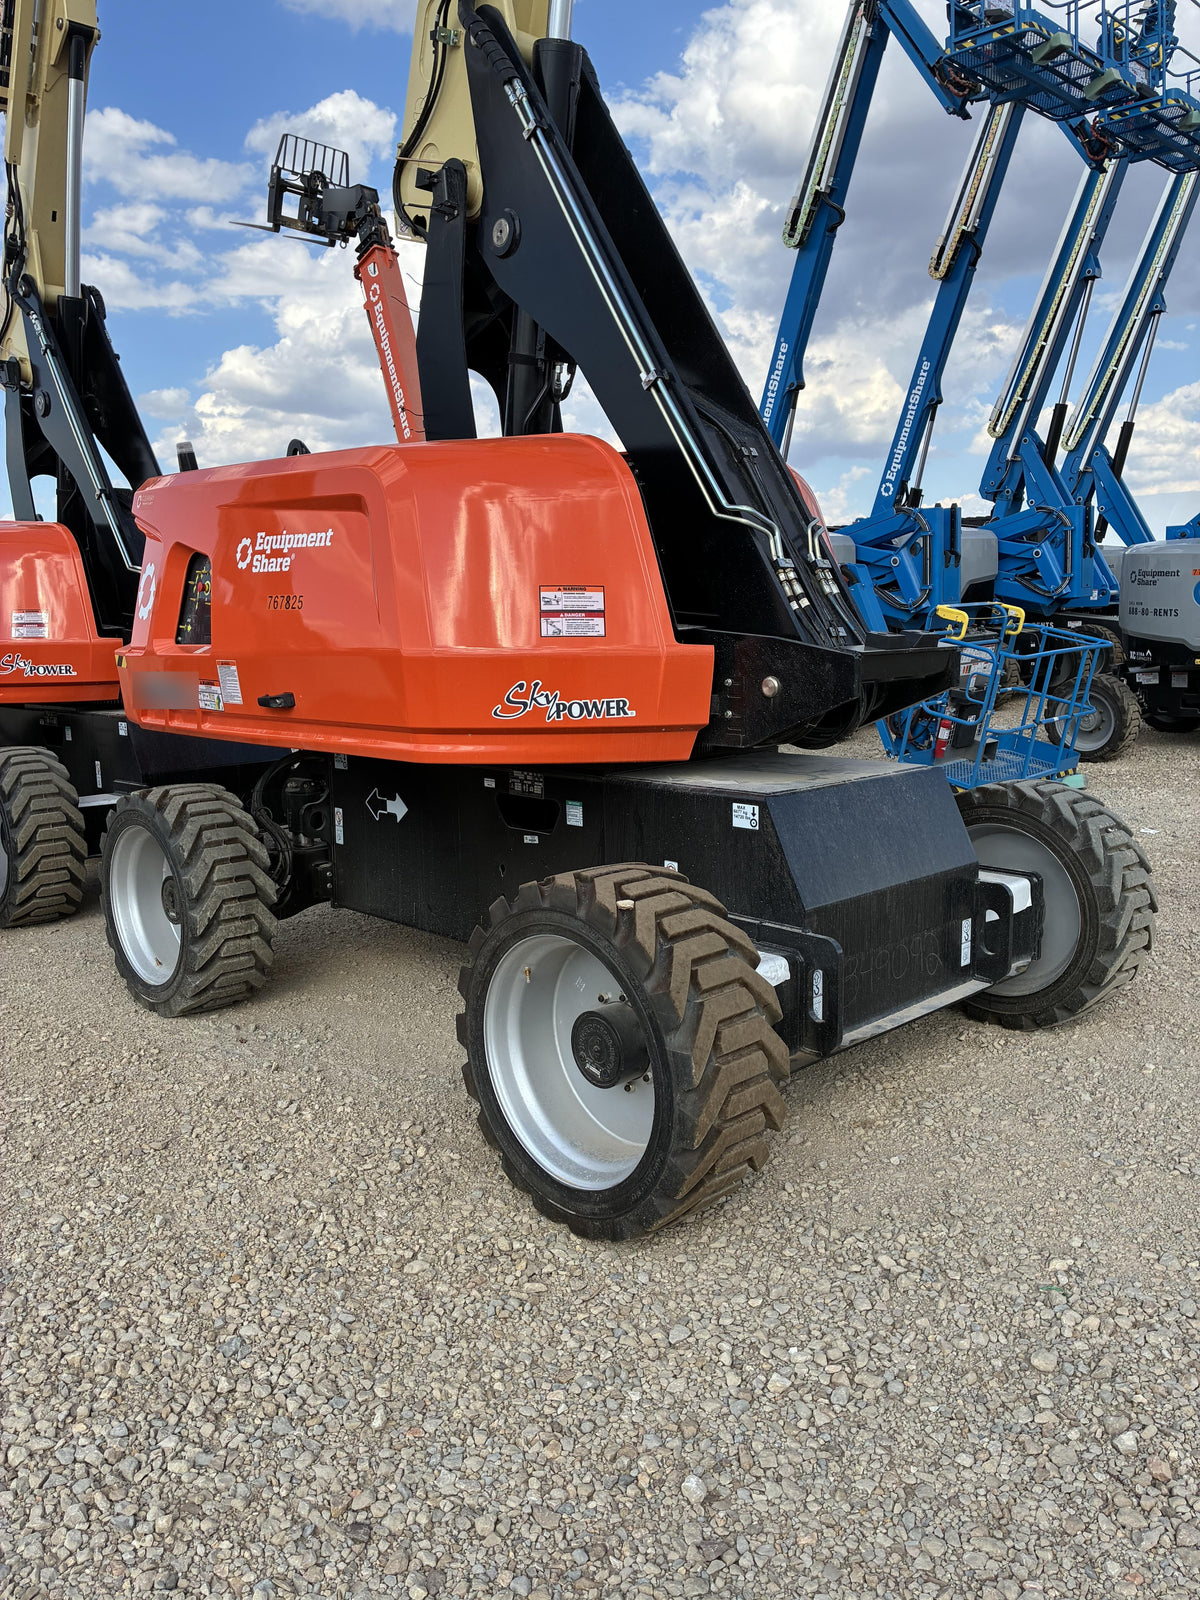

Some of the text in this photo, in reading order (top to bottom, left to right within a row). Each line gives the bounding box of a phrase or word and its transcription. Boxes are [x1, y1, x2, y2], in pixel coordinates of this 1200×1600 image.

[373, 302, 411, 439] EquipmentShare
[885, 360, 931, 482] EquipmentShare
[255, 528, 334, 553] Equipment
[252, 554, 291, 573] Share
[1137, 568, 1180, 580] Equipment
[1137, 578, 1158, 587] Share
[267, 595, 304, 610] 767825
